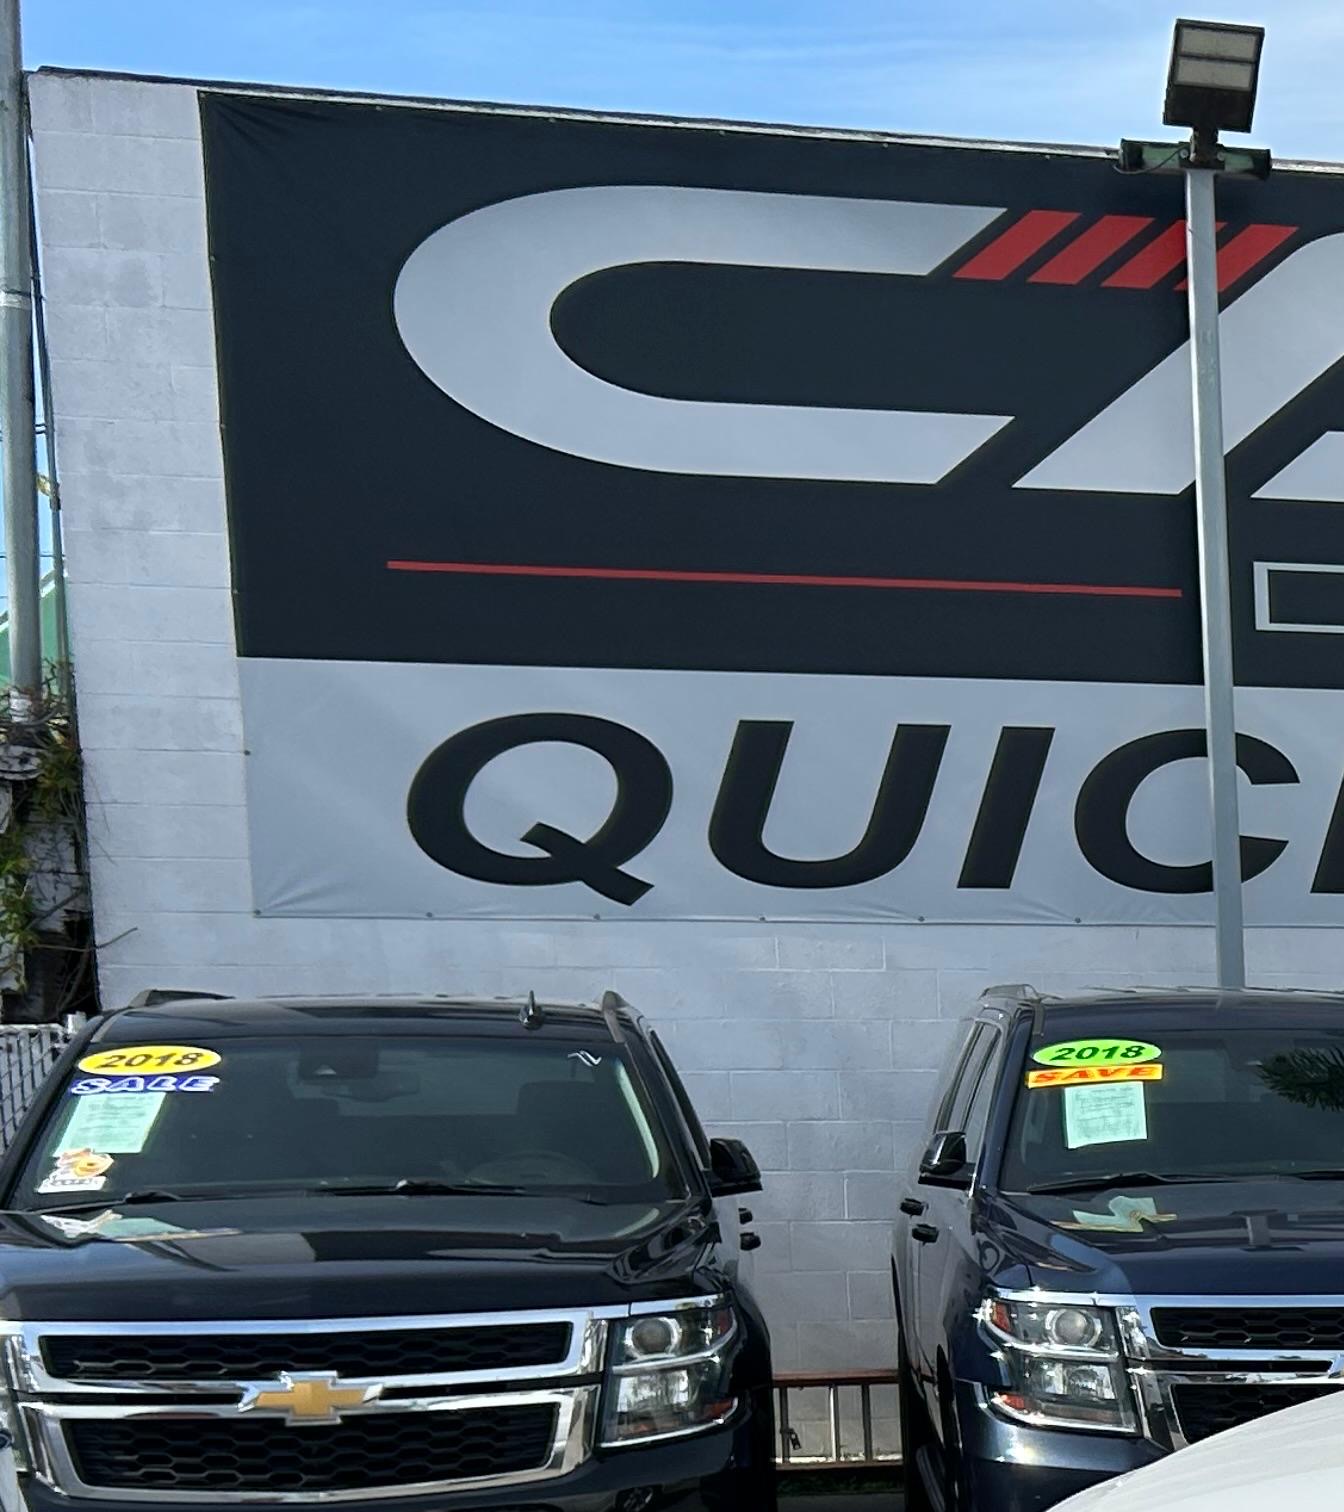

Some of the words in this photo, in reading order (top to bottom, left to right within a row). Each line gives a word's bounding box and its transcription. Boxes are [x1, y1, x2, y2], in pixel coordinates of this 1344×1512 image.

[95, 1052, 206, 1069] 2018
[1049, 1045, 1147, 1061] 2018
[1035, 1067, 1155, 1083] SAVE
[71, 1076, 220, 1094] SALE
